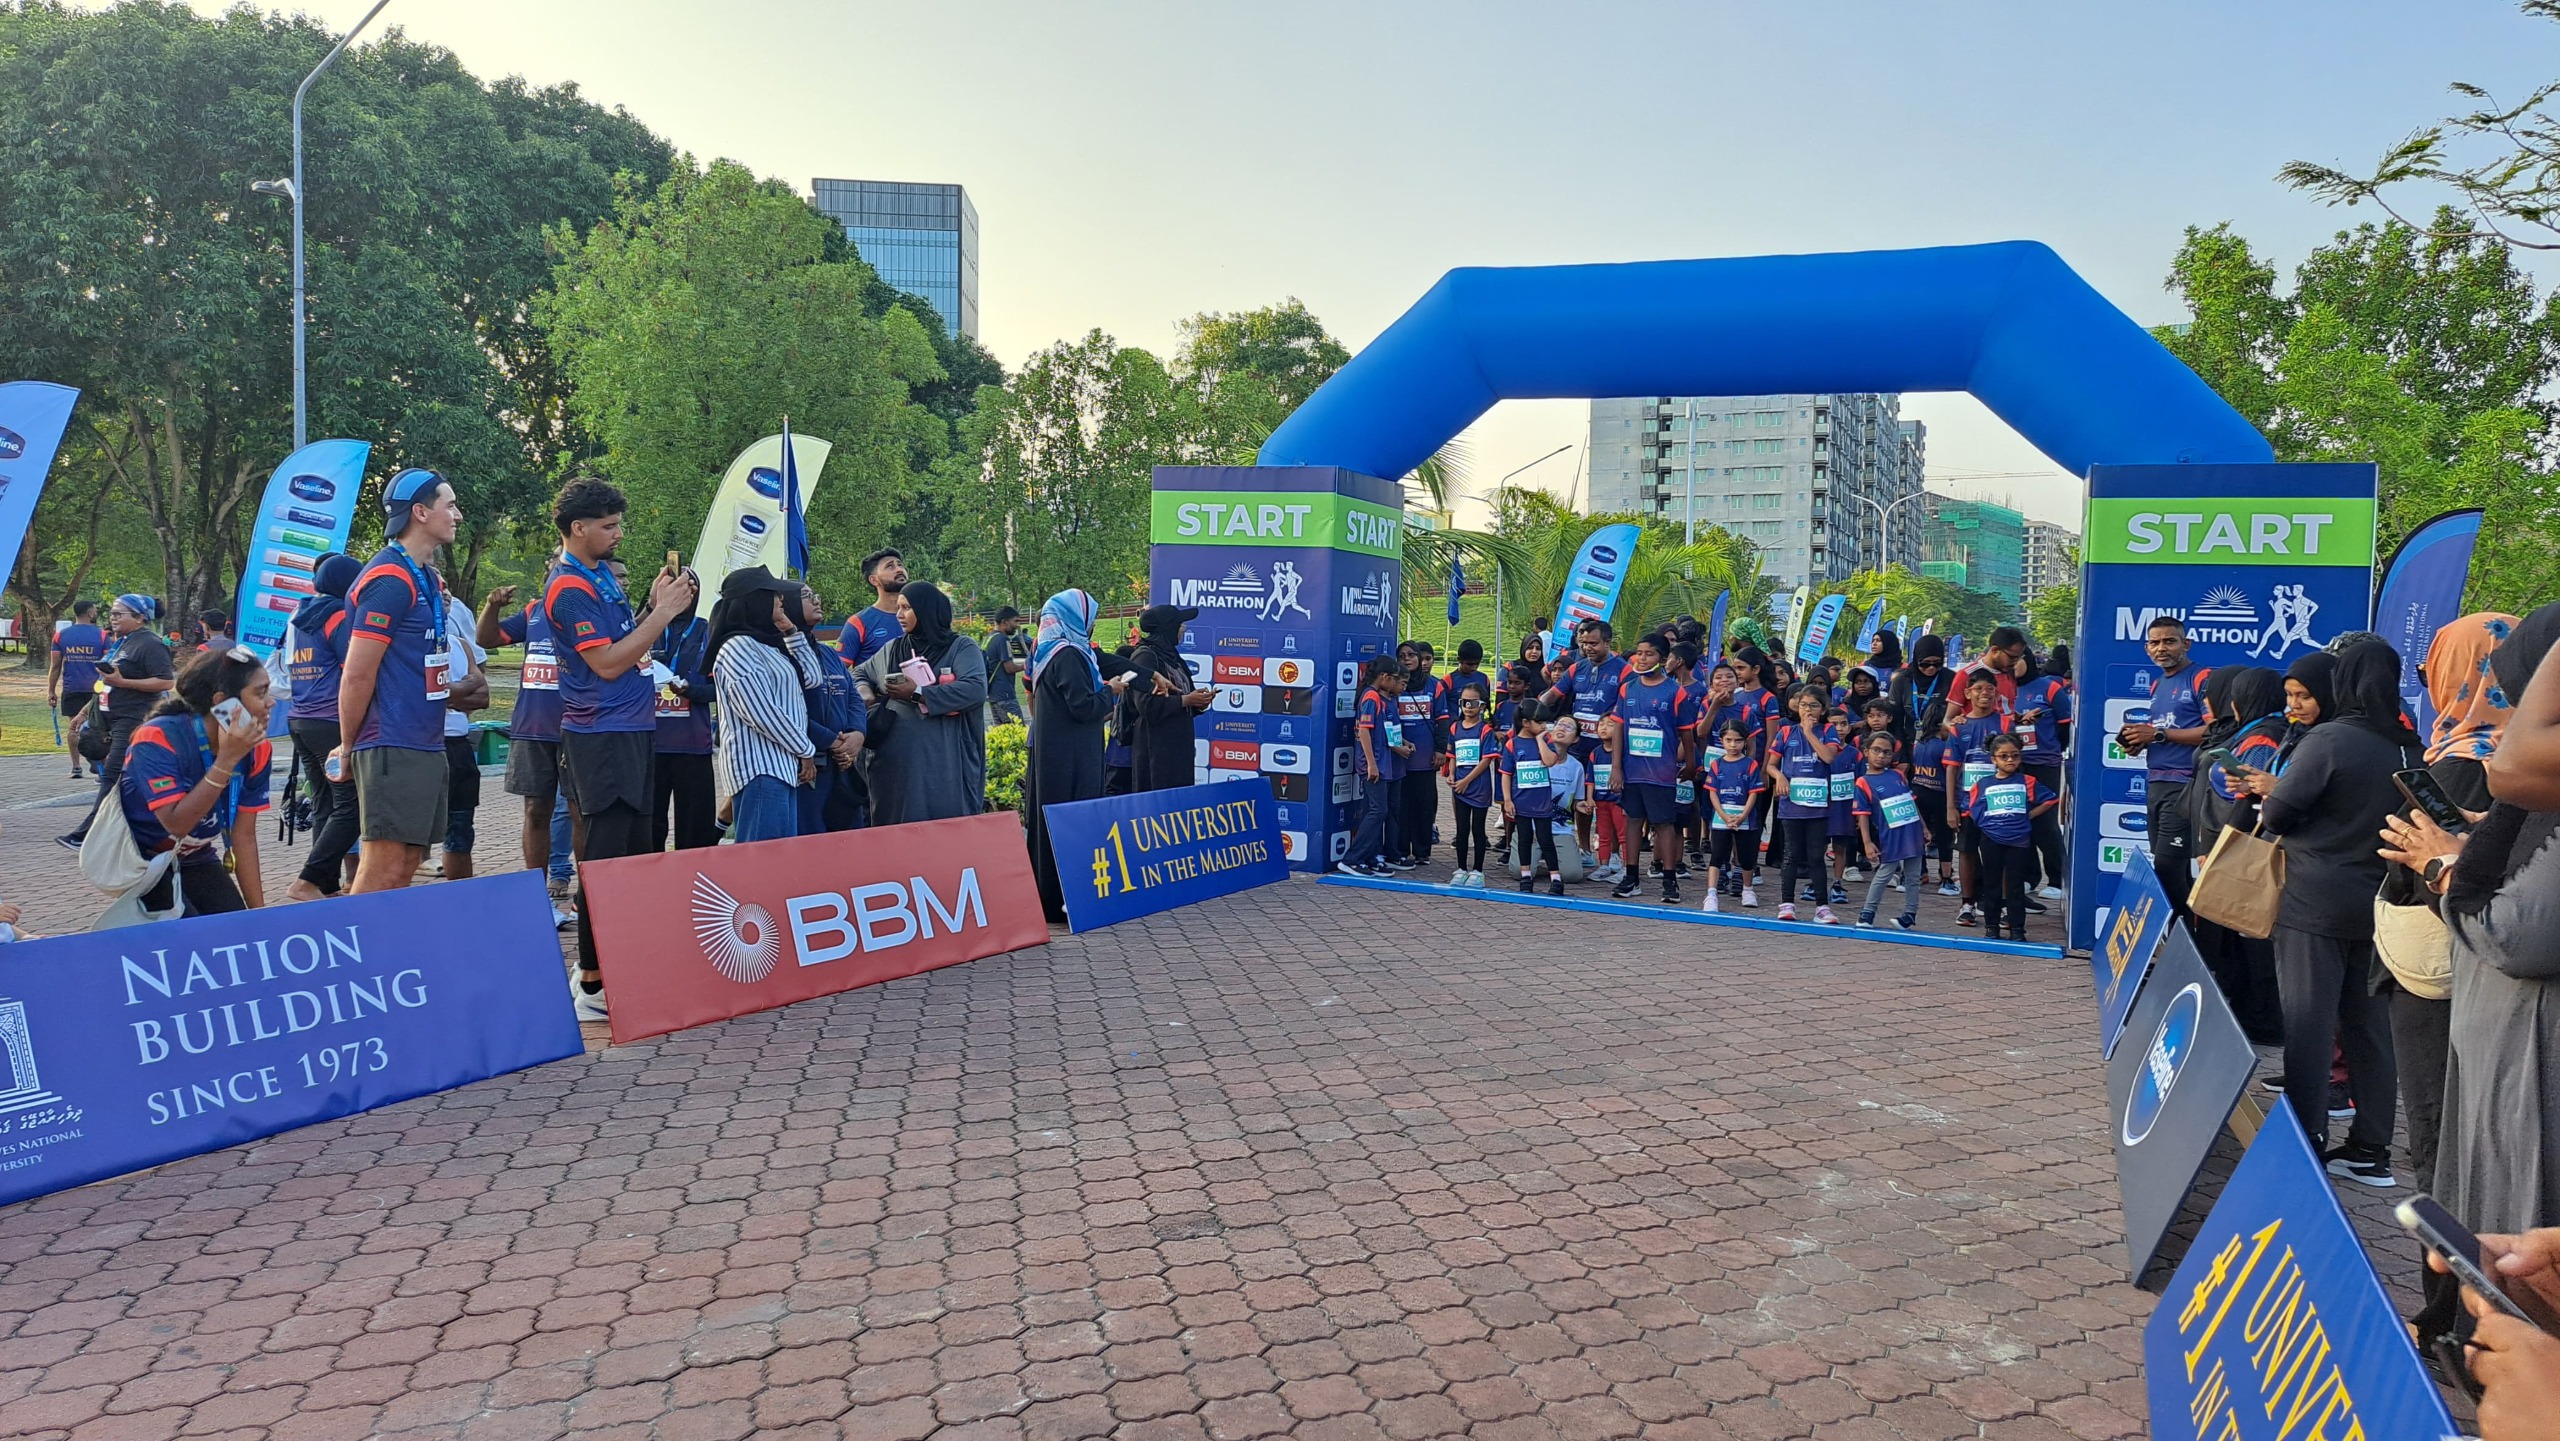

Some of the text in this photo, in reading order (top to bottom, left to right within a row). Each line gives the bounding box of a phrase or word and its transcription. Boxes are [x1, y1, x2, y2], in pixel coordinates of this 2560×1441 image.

[294, 481, 332, 495] Vaseline
[1177, 503, 1311, 538] START
[1346, 510, 1396, 550] START
[2125, 512, 2333, 555] START
[249, 635, 262, 643] for
[66, 646, 94, 654] MNU
[527, 668, 552, 679] 6711
[1228, 667, 1260, 676] BBM
[1632, 739, 1655, 748] K047
[1225, 751, 1257, 761] BBM
[1522, 771, 1544, 780] K061
[1796, 788, 1823, 798] K023
[1993, 795, 2021, 805] K038
[1891, 804, 1915, 818] K053
[1130, 800, 1259, 852] UNIVERSITY
[1141, 840, 1268, 889] IN THE MALDIVES
[786, 867, 988, 967] BBM
[121, 925, 364, 1007] NATION
[129, 968, 429, 1066] BUILDING
[2149, 1021, 2175, 1103] Vaseline
[147, 1037, 389, 1126] SINCE 1973
[19, 1129, 84, 1152] NATIONAL
